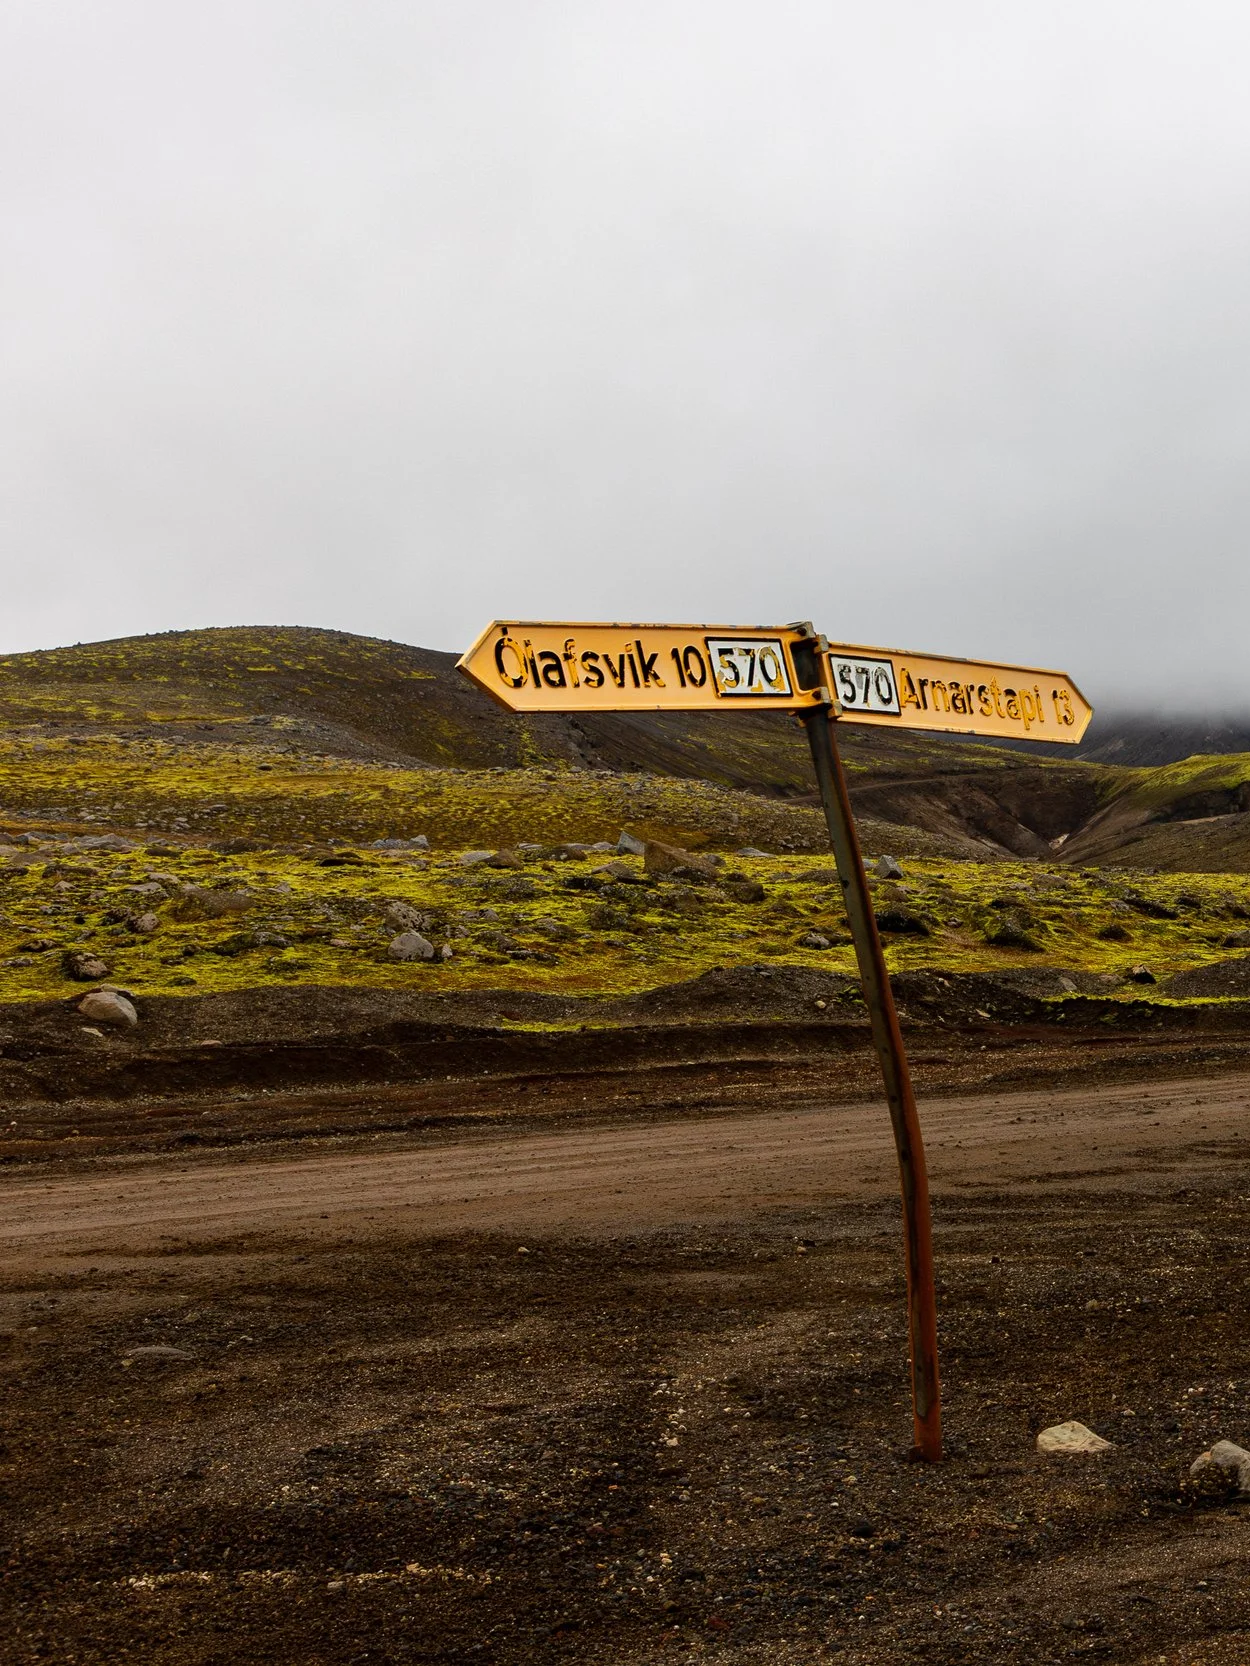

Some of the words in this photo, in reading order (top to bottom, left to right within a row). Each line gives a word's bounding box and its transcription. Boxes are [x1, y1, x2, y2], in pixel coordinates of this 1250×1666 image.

[671, 645, 706, 687] 10
[719, 648, 786, 688] 570
[838, 663, 892, 705] 570
[900, 667, 1044, 730] Arnarstapi
[1052, 689, 1075, 726] 13
